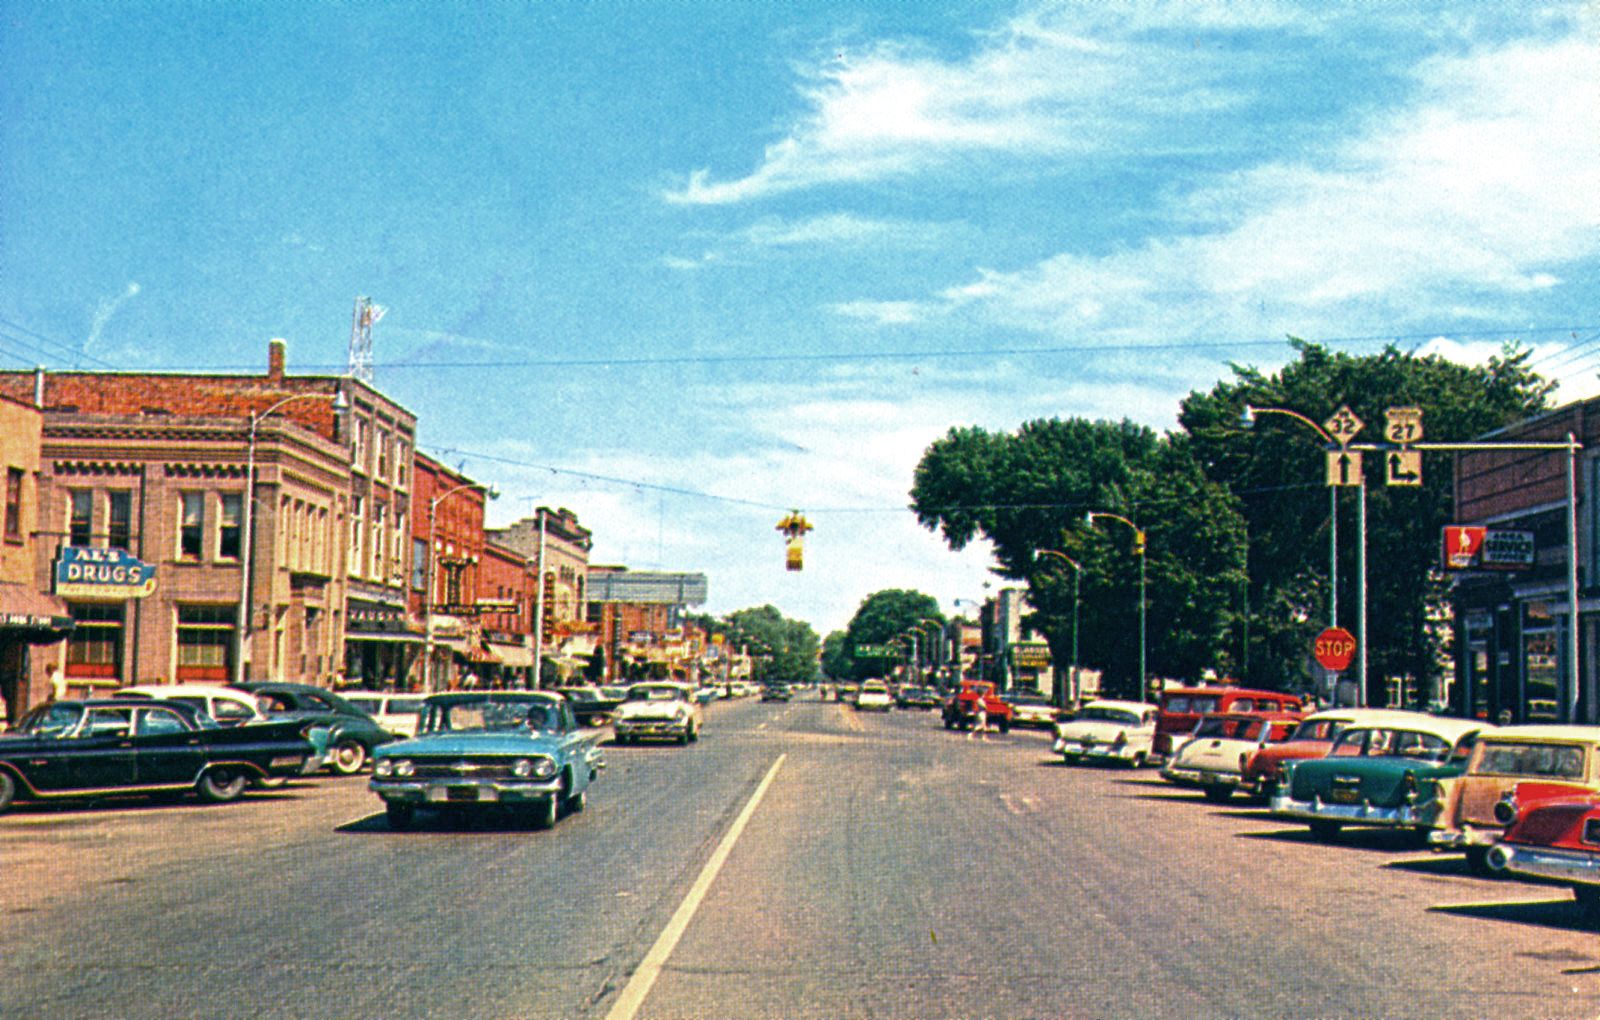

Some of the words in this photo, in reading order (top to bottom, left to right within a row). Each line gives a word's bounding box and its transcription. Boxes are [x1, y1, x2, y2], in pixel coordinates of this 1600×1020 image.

[1331, 419, 1355, 434] 32
[1391, 424, 1415, 440] 27
[68, 563, 142, 583] DRUGS
[1315, 640, 1354, 657] STOP
